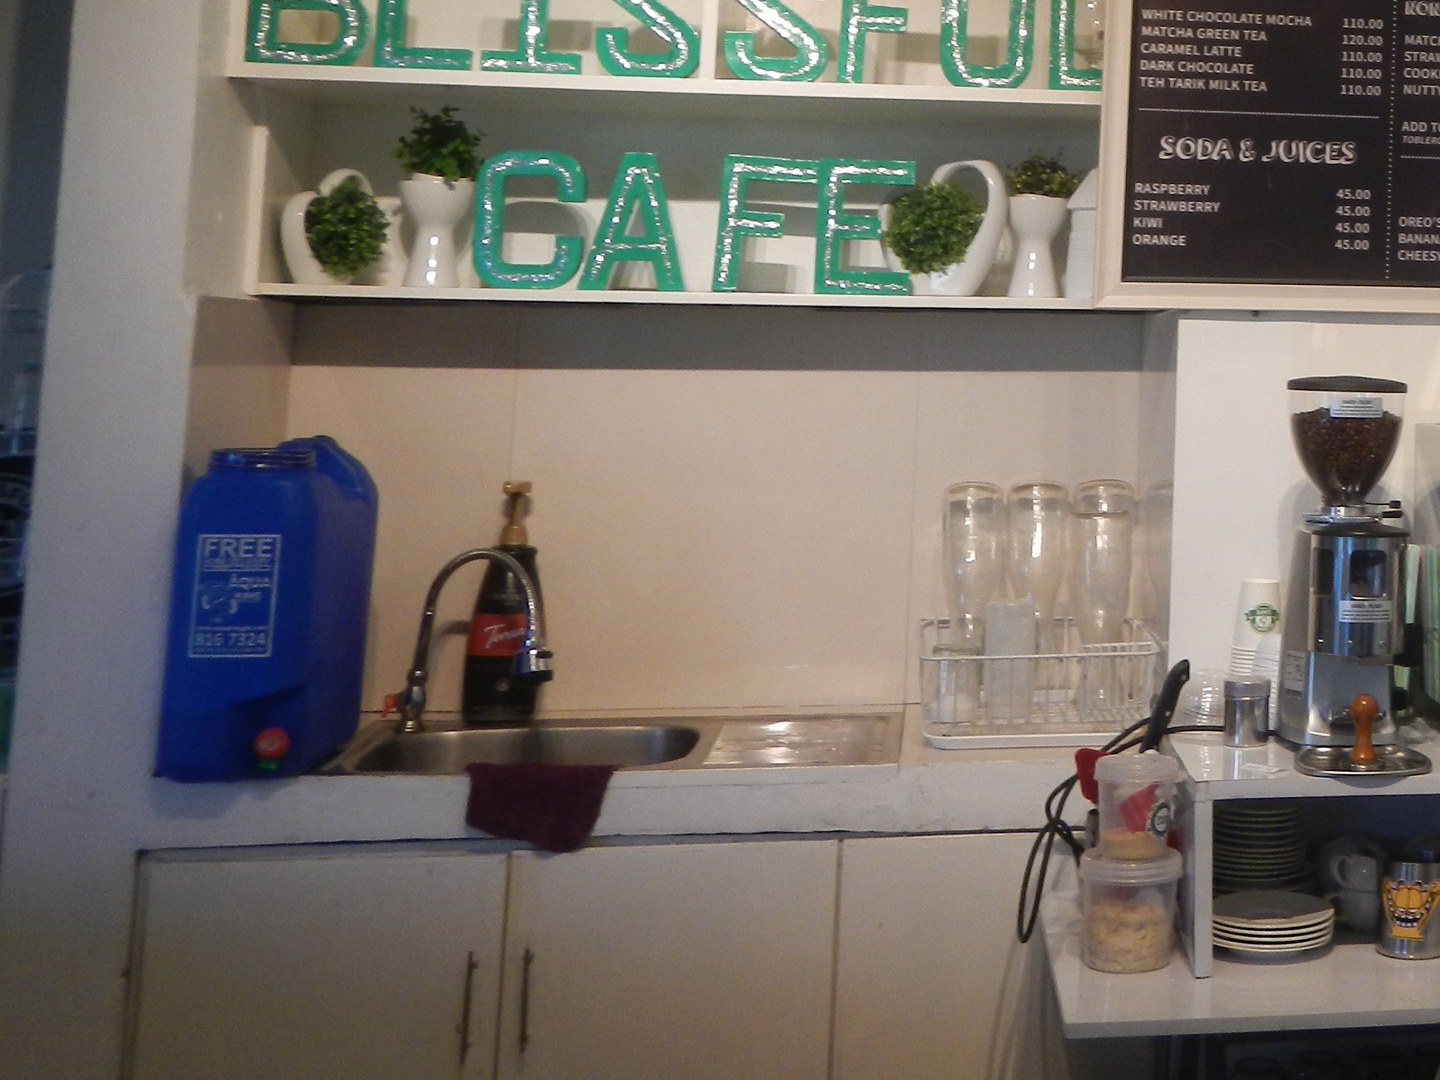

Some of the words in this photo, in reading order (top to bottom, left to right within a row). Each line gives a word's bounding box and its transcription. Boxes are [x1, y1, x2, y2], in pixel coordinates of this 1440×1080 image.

[1142, 9, 1183, 21] WHITE
[1187, 10, 1262, 25] CHOCOLATE
[1266, 13, 1312, 26] MOCHA
[1343, 19, 1383, 29] 110.00
[1141, 26, 1194, 38] MATCHA
[1197, 28, 1239, 41] GREEN
[1243, 30, 1267, 41] TEA
[1141, 43, 1200, 55] CARAMEL
[1204, 45, 1242, 57] LATTE
[1140, 60, 1174, 71] DARK
[1178, 61, 1254, 75] CHOCOLATE
[1402, 122, 1428, 132] ADD
[1159, 135, 1234, 161] SODA
[1239, 138, 1256, 162] &
[1261, 139, 1357, 164] JUICES
[1135, 182, 1210, 196] RASPBERRY
[1336, 189, 1371, 200] 45.00
[1134, 199, 1220, 213] STRAWBERRY
[1336, 206, 1370, 217] 45.00
[473, 150, 916, 295] CAFE
[1133, 217, 1163, 228] KIWI
[1336, 223, 1370, 233] 45.00
[1133, 234, 1186, 247] ORANGE
[1335, 240, 1369, 250] 45.00
[204, 538, 273, 558] FREE
